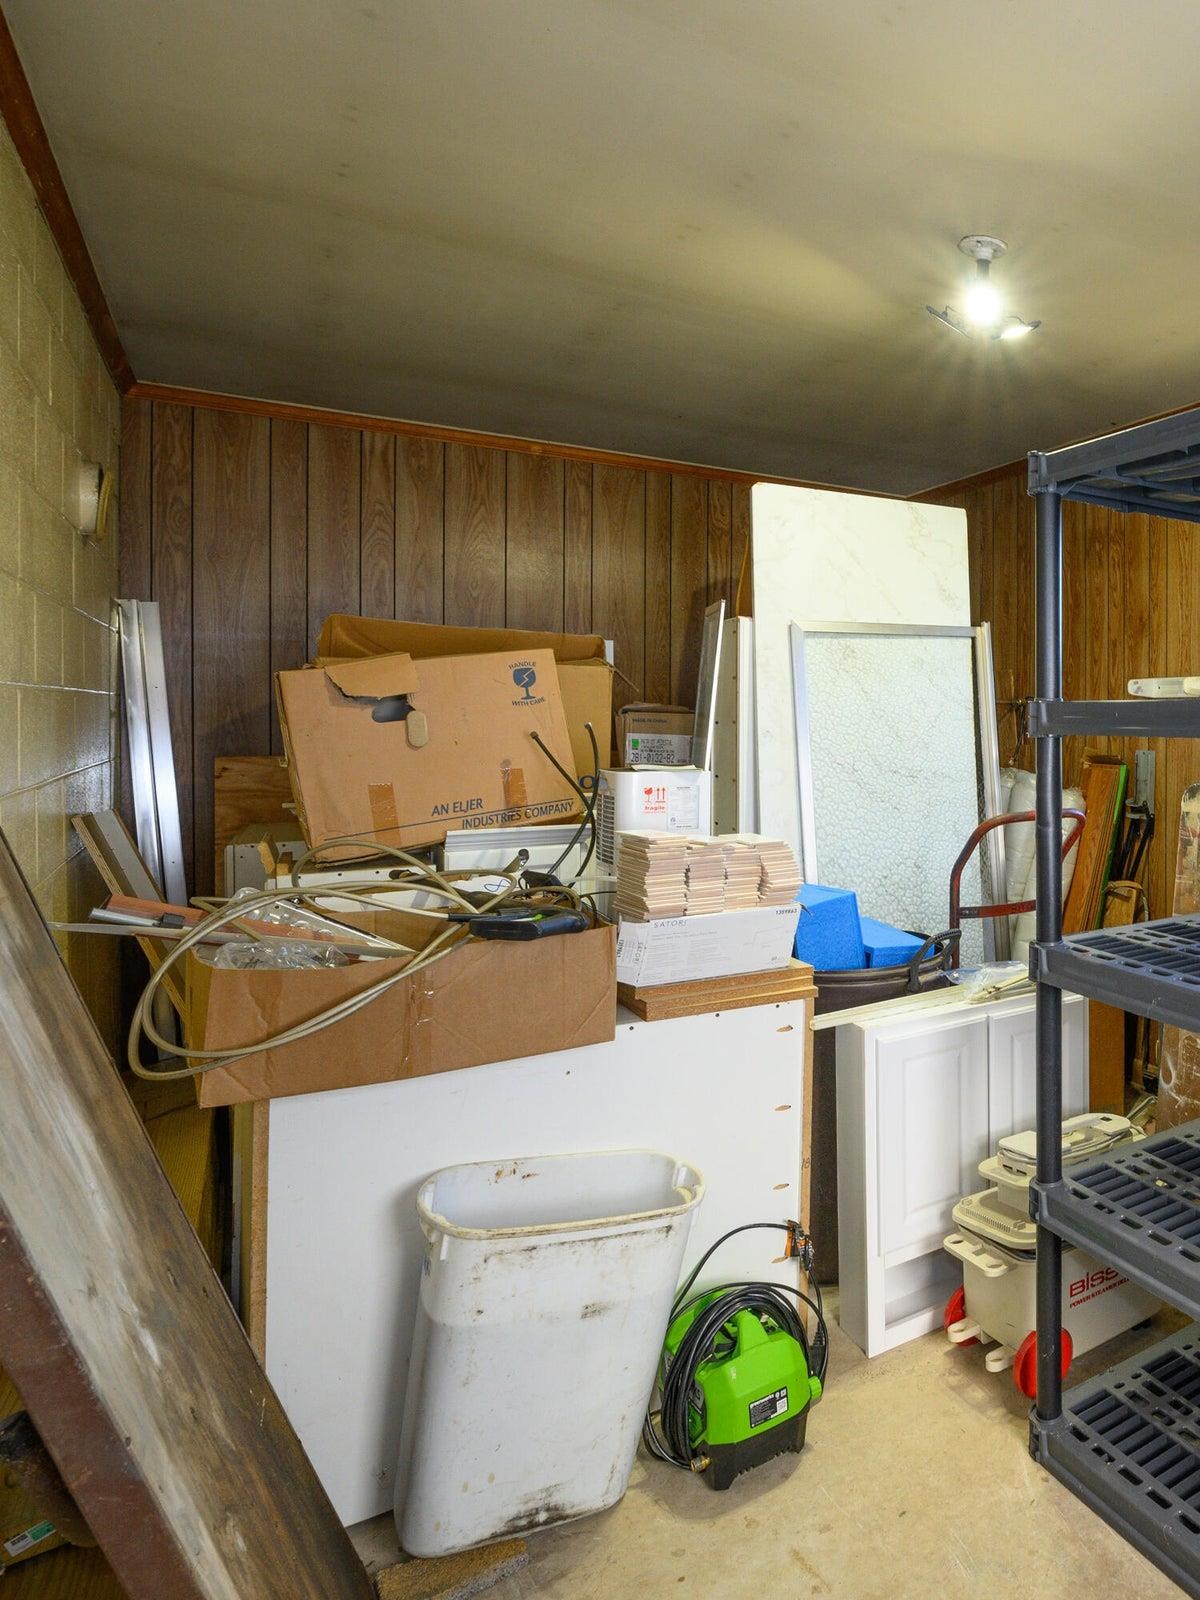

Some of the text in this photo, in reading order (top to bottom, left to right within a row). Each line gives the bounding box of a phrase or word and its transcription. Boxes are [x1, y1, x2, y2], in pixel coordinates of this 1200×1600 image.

[508, 661, 537, 669] HANDLE
[529, 697, 546, 706] CARE
[431, 798, 484, 816] AN ELJER
[462, 801, 575, 829] INDUSTRIES COMPANY
[654, 919, 688, 928] SATORI
[1069, 1267, 1119, 1298] BISS
